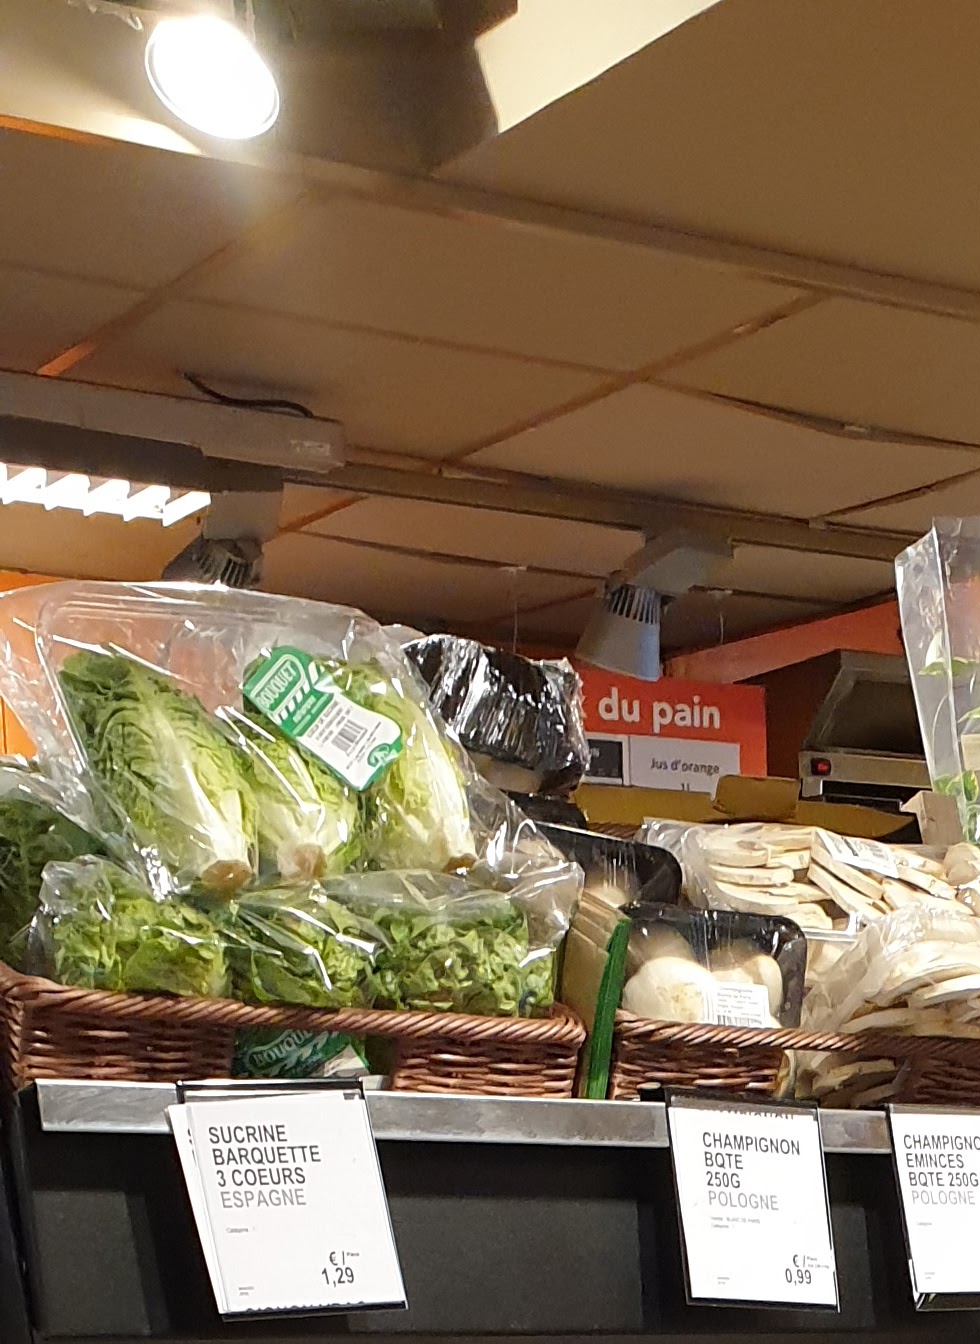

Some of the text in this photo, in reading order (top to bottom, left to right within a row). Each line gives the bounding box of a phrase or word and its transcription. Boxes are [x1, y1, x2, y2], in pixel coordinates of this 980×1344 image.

[599, 687, 721, 734] du pain
[650, 757, 720, 776] Jus d'orange
[208, 1124, 288, 1144] SUCRINE
[702, 1131, 801, 1156] CHAMPIGNON
[212, 1145, 321, 1166] BARQUETTE
[704, 1151, 744, 1171] BQTE
[905, 1152, 965, 1169] EMINCES
[217, 1166, 306, 1187] 3 COEURS
[706, 1170, 741, 1189] 250G
[908, 1171, 980, 1188] BQTE 250G
[220, 1188, 307, 1209] ESPAGNE
[708, 1190, 780, 1212] POLOGNE
[911, 1189, 977, 1206] POLOGNE
[321, 1266, 355, 1288] 1,29
[785, 1267, 812, 1286] 0,99
